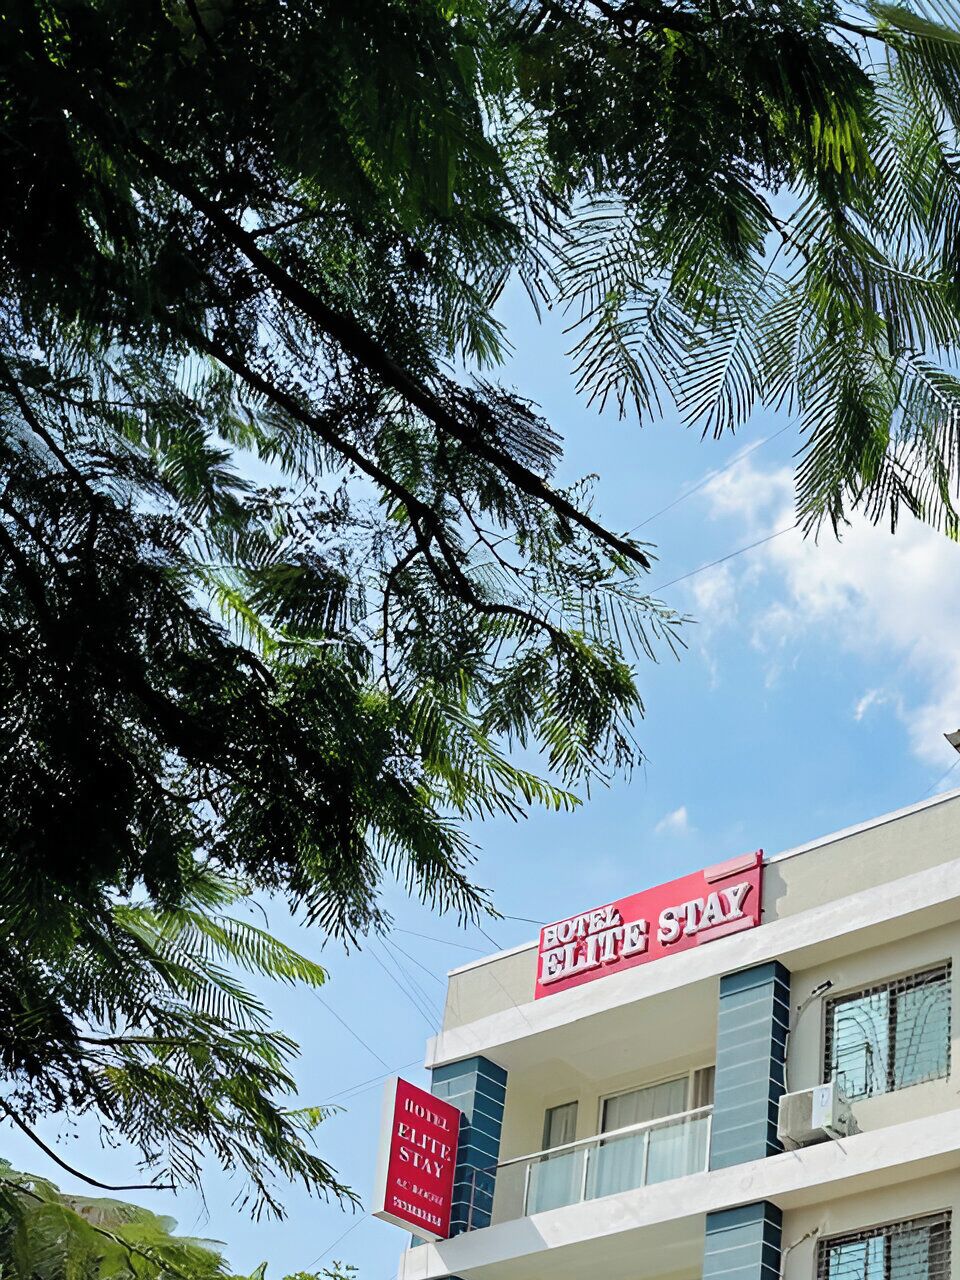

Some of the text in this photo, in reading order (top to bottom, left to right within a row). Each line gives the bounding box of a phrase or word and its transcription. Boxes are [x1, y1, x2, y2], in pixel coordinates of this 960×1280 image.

[538, 882, 751, 984] ELITE STAY
[544, 905, 620, 949] HOTEL
[404, 1098, 450, 1132] HOTEL
[397, 1122, 451, 1161] ELITE
[399, 1146, 444, 1179] STAY
